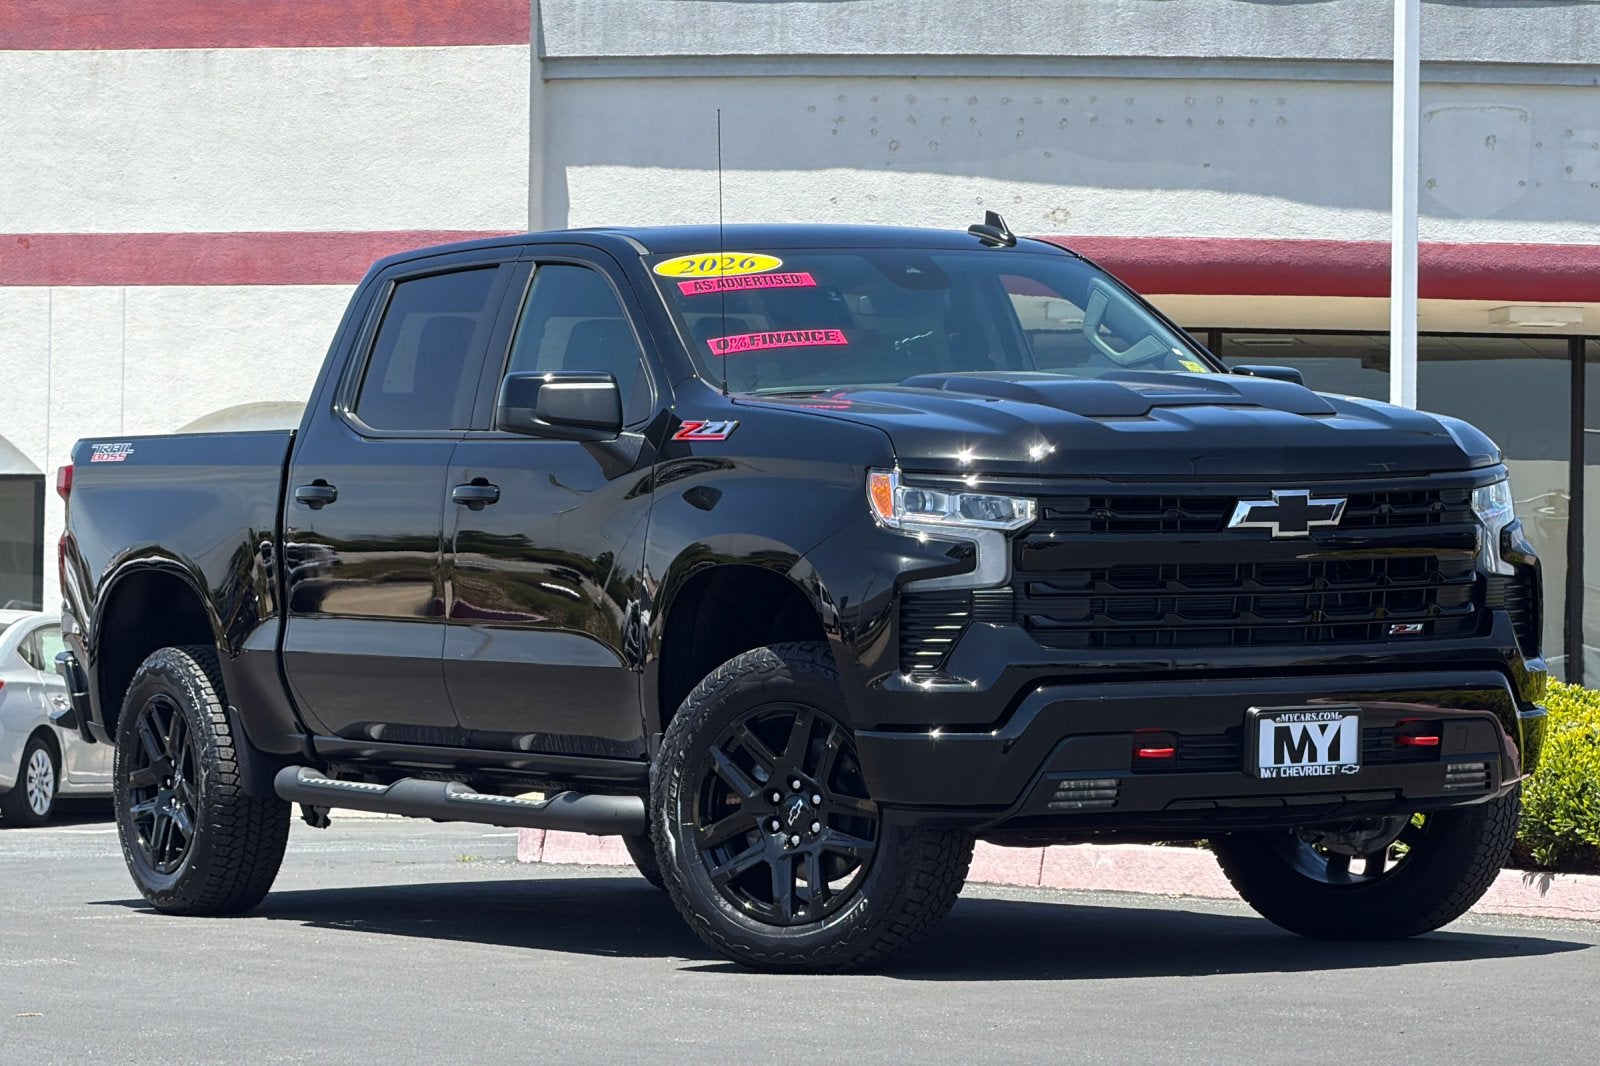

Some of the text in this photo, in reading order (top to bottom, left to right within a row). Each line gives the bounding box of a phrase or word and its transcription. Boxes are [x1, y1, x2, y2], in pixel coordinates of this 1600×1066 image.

[679, 256, 756, 274] 2026
[694, 275, 801, 292] AS ADVERTISED
[716, 331, 838, 351] 0% FINANCE
[671, 420, 740, 441] Z71
[91, 442, 135, 454] TRAIL
[90, 453, 127, 462] BOSS
[1273, 722, 1342, 765] MY
[1260, 765, 1337, 779] MY CHEVROLET
